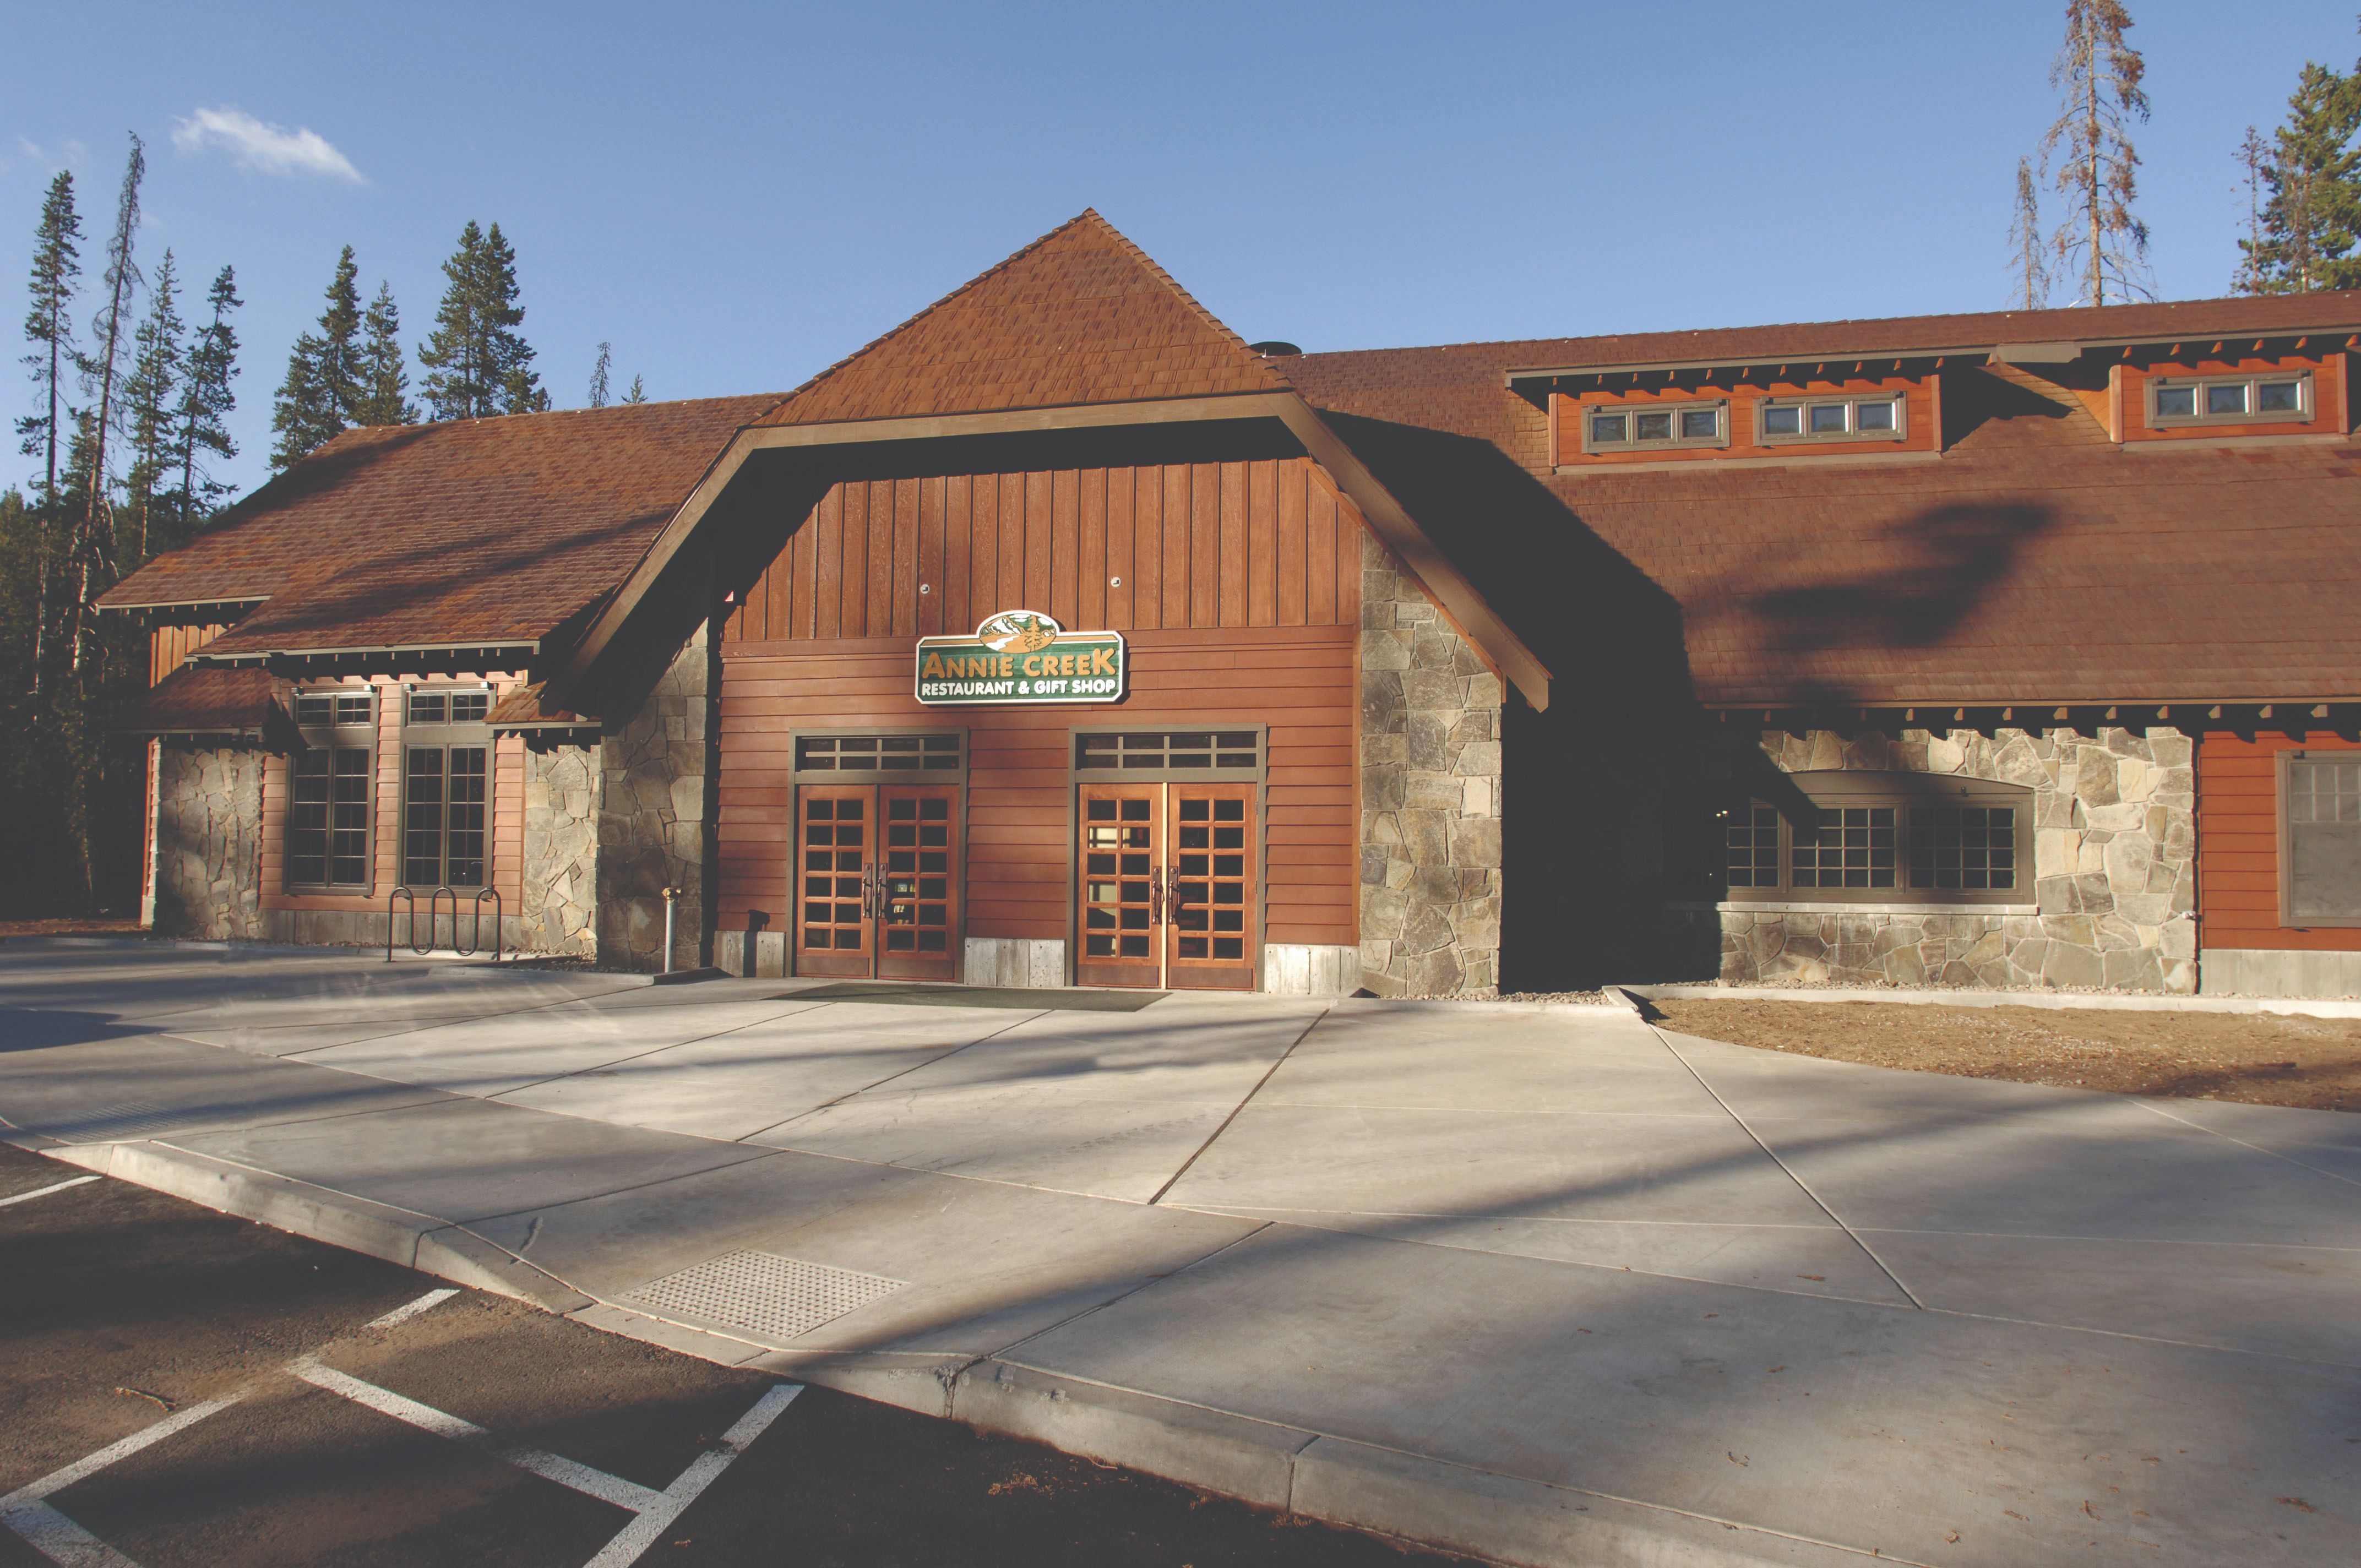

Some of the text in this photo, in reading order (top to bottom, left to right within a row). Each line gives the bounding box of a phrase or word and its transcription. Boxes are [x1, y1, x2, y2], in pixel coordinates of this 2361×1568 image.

[922, 648, 1116, 679] ANNIE CREEK
[922, 679, 1116, 696] RESTAURANT & GIFT SHOP
